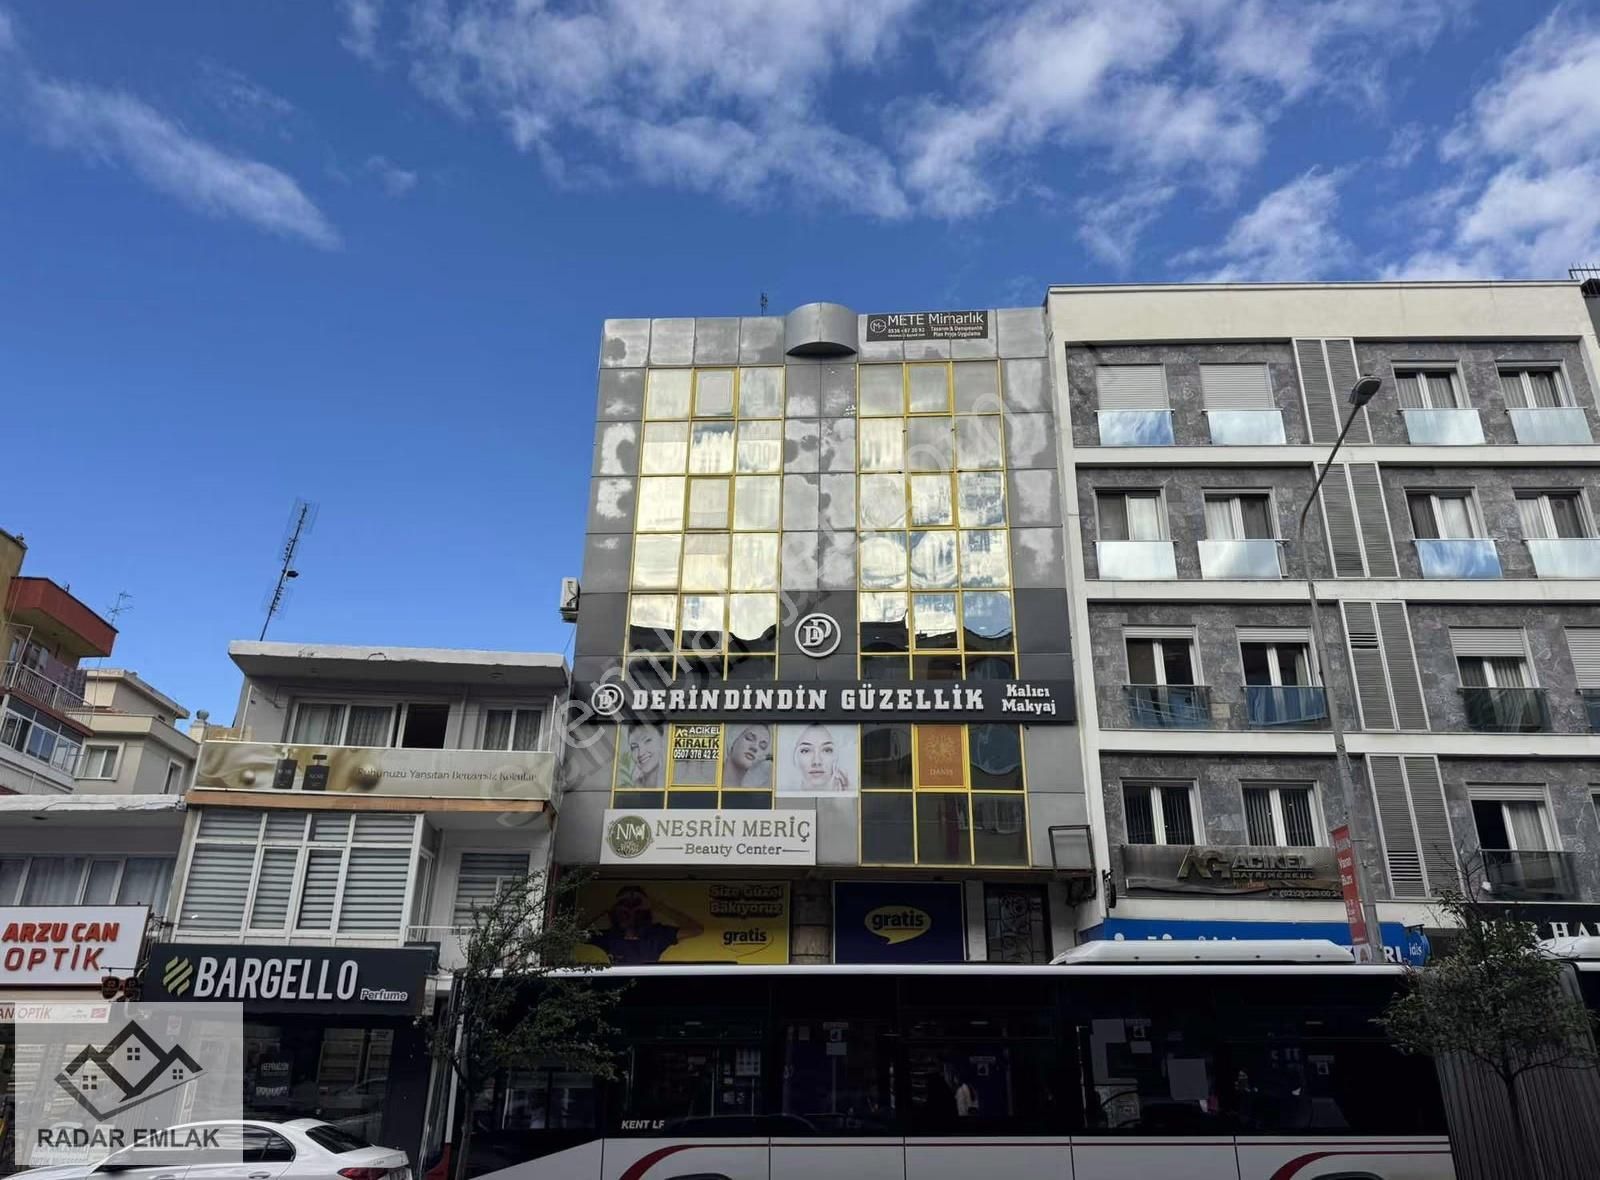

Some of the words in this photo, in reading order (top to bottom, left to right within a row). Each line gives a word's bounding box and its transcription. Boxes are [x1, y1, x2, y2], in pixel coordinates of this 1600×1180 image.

[888, 313, 925, 326] METE
[631, 685, 827, 710] DERİNDİNDİN
[841, 684, 984, 710] GÜZELLİK
[1005, 684, 1050, 697] Kalıcı
[1001, 699, 1056, 715] Makyaj
[673, 749, 688, 759] 0507
[357, 767, 407, 779] Ruhunuzu
[656, 816, 736, 837] NESRİN
[742, 816, 810, 842] MERİÇ
[685, 843, 732, 857] Beauty
[736, 843, 782, 855] Center
[709, 885, 740, 897] Size
[743, 884, 783, 898] Güzel
[872, 910, 925, 930] gratis
[2, 922, 69, 943] ARZU
[71, 922, 120, 943] CAN
[723, 928, 767, 945] gratis
[4, 944, 104, 972] OPTİK
[193, 956, 359, 1000] BARGELLO
[360, 988, 408, 1001] Perfume
[17, 1004, 53, 1019] OPTİK
[621, 1119, 650, 1130] KENT
[652, 1119, 665, 1130] LF
